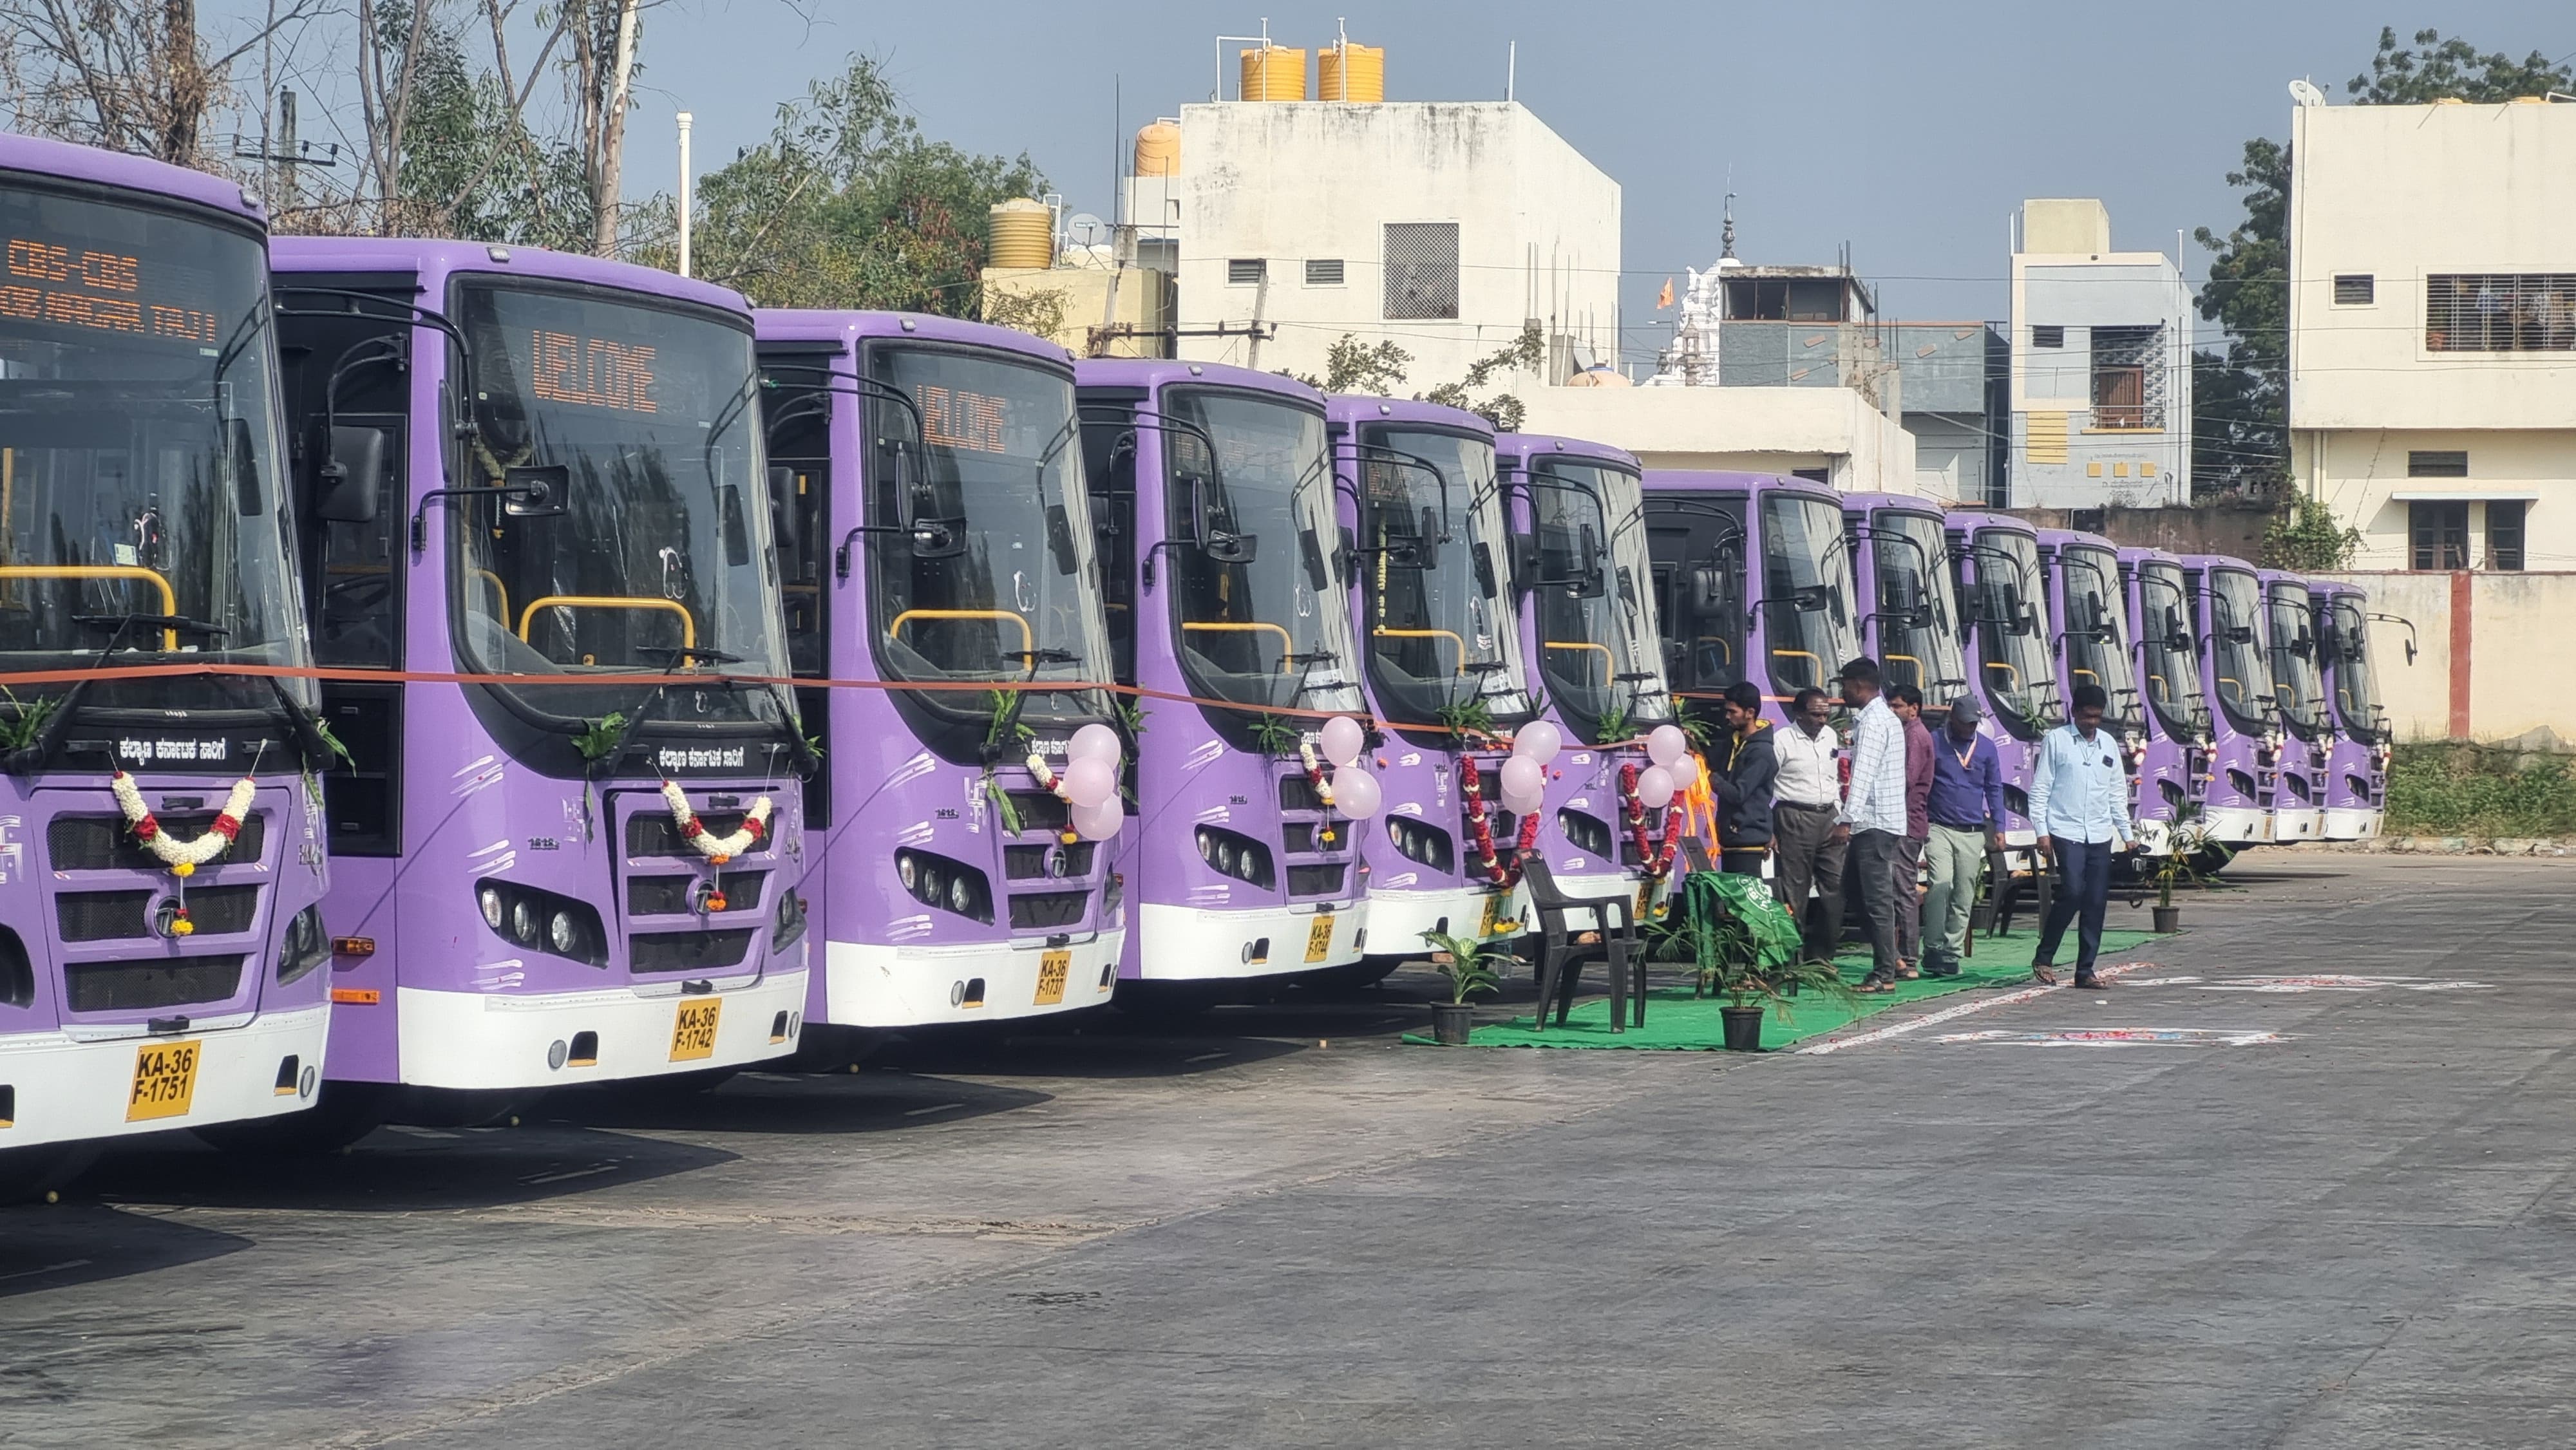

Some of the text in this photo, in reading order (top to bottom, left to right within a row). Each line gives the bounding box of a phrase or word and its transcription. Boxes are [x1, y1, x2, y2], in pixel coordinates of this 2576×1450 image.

[8, 239, 138, 292] CBS-CBS
[533, 329, 658, 413] WELCOME
[119, 736, 226, 766] ಕಲ್ಯಾಣ ಕರ್ನಾಟಕ ಸಾರಿಗೆ
[659, 746, 744, 773] ಕಲ್ಯಾಣ ಕರ್ನಾಟಕ ಸಾರಿಗೆ
[1311, 924, 1331, 940] KA-36
[1041, 959, 1066, 977] KA-36
[1037, 978, 1064, 995] F-1737
[678, 1007, 716, 1030] KA-36
[674, 1028, 713, 1051] F-1742
[137, 1048, 193, 1078] KA-36
[132, 1074, 187, 1104] F-1751
